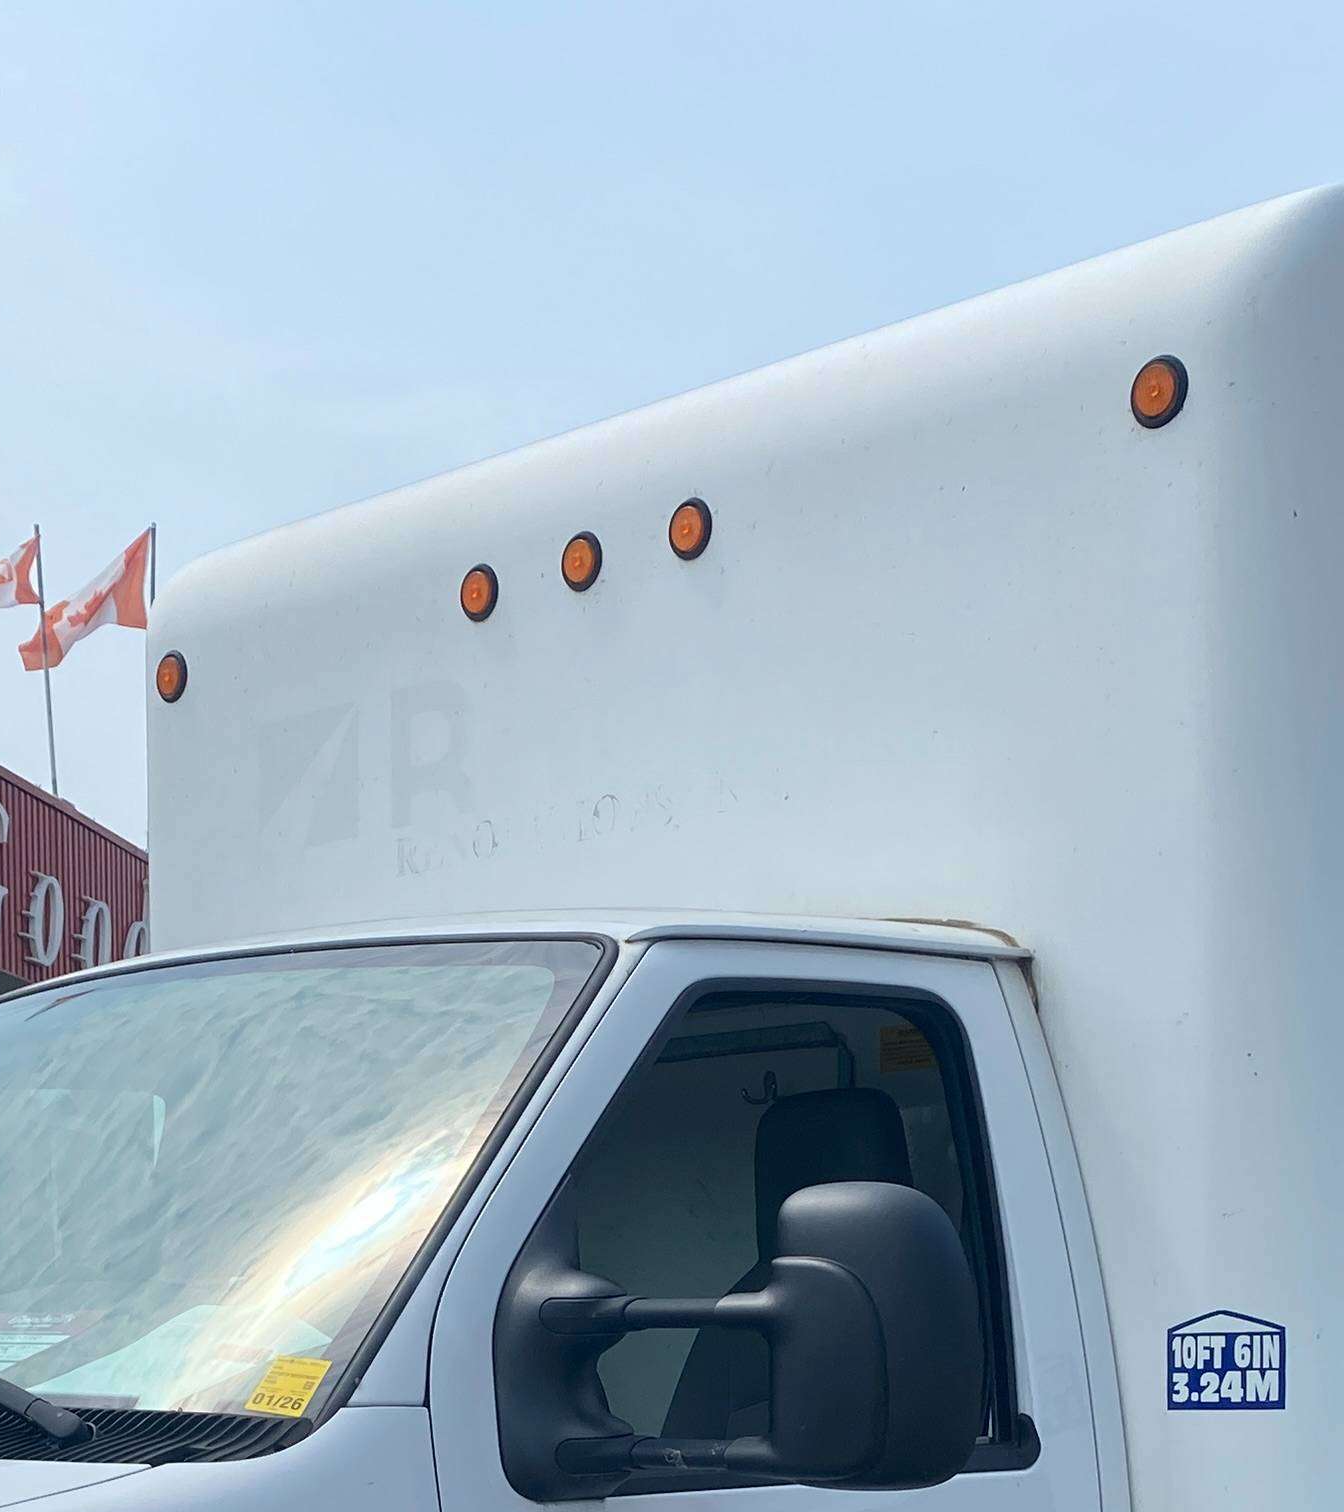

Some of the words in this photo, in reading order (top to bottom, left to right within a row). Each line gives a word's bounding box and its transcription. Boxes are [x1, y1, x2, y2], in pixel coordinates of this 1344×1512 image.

[1172, 1335, 1226, 1369] 10FT
[1234, 1335, 1280, 1369] 6IN
[251, 1392, 305, 1411] 01/26
[1172, 1370, 1279, 1403] 3.24M
